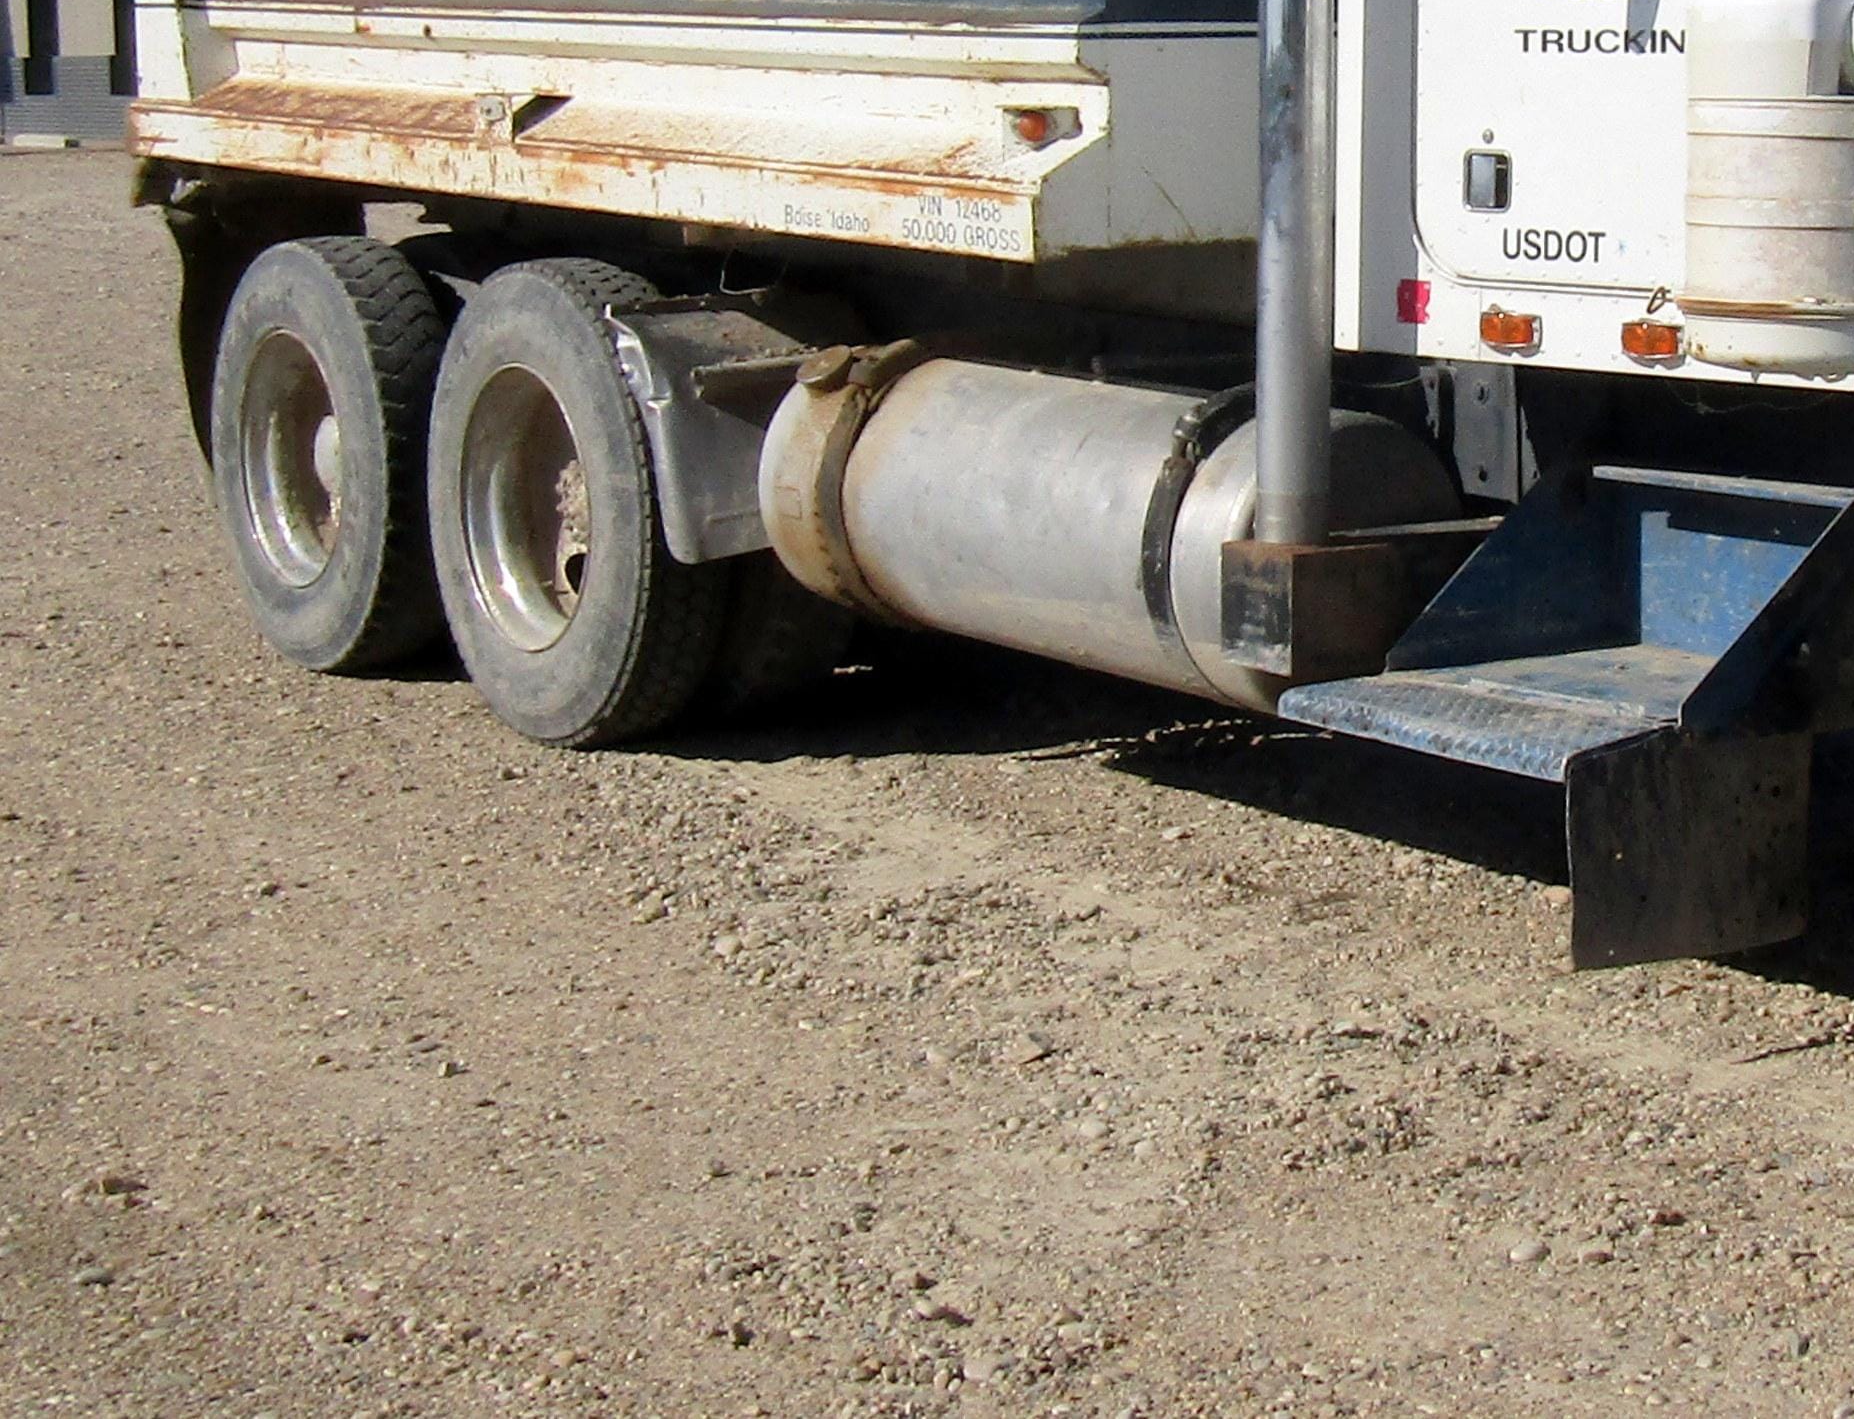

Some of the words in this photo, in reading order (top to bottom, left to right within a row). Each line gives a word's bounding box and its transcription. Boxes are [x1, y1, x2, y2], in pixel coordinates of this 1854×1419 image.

[1515, 28, 1686, 55] TRUCKIN
[832, 211, 870, 233] Idaho
[918, 195, 943, 216] VIN
[955, 200, 1002, 223] 12468
[902, 218, 957, 245] 50,000
[963, 224, 1022, 252] GROSS
[1503, 229, 1607, 264] USDOT
